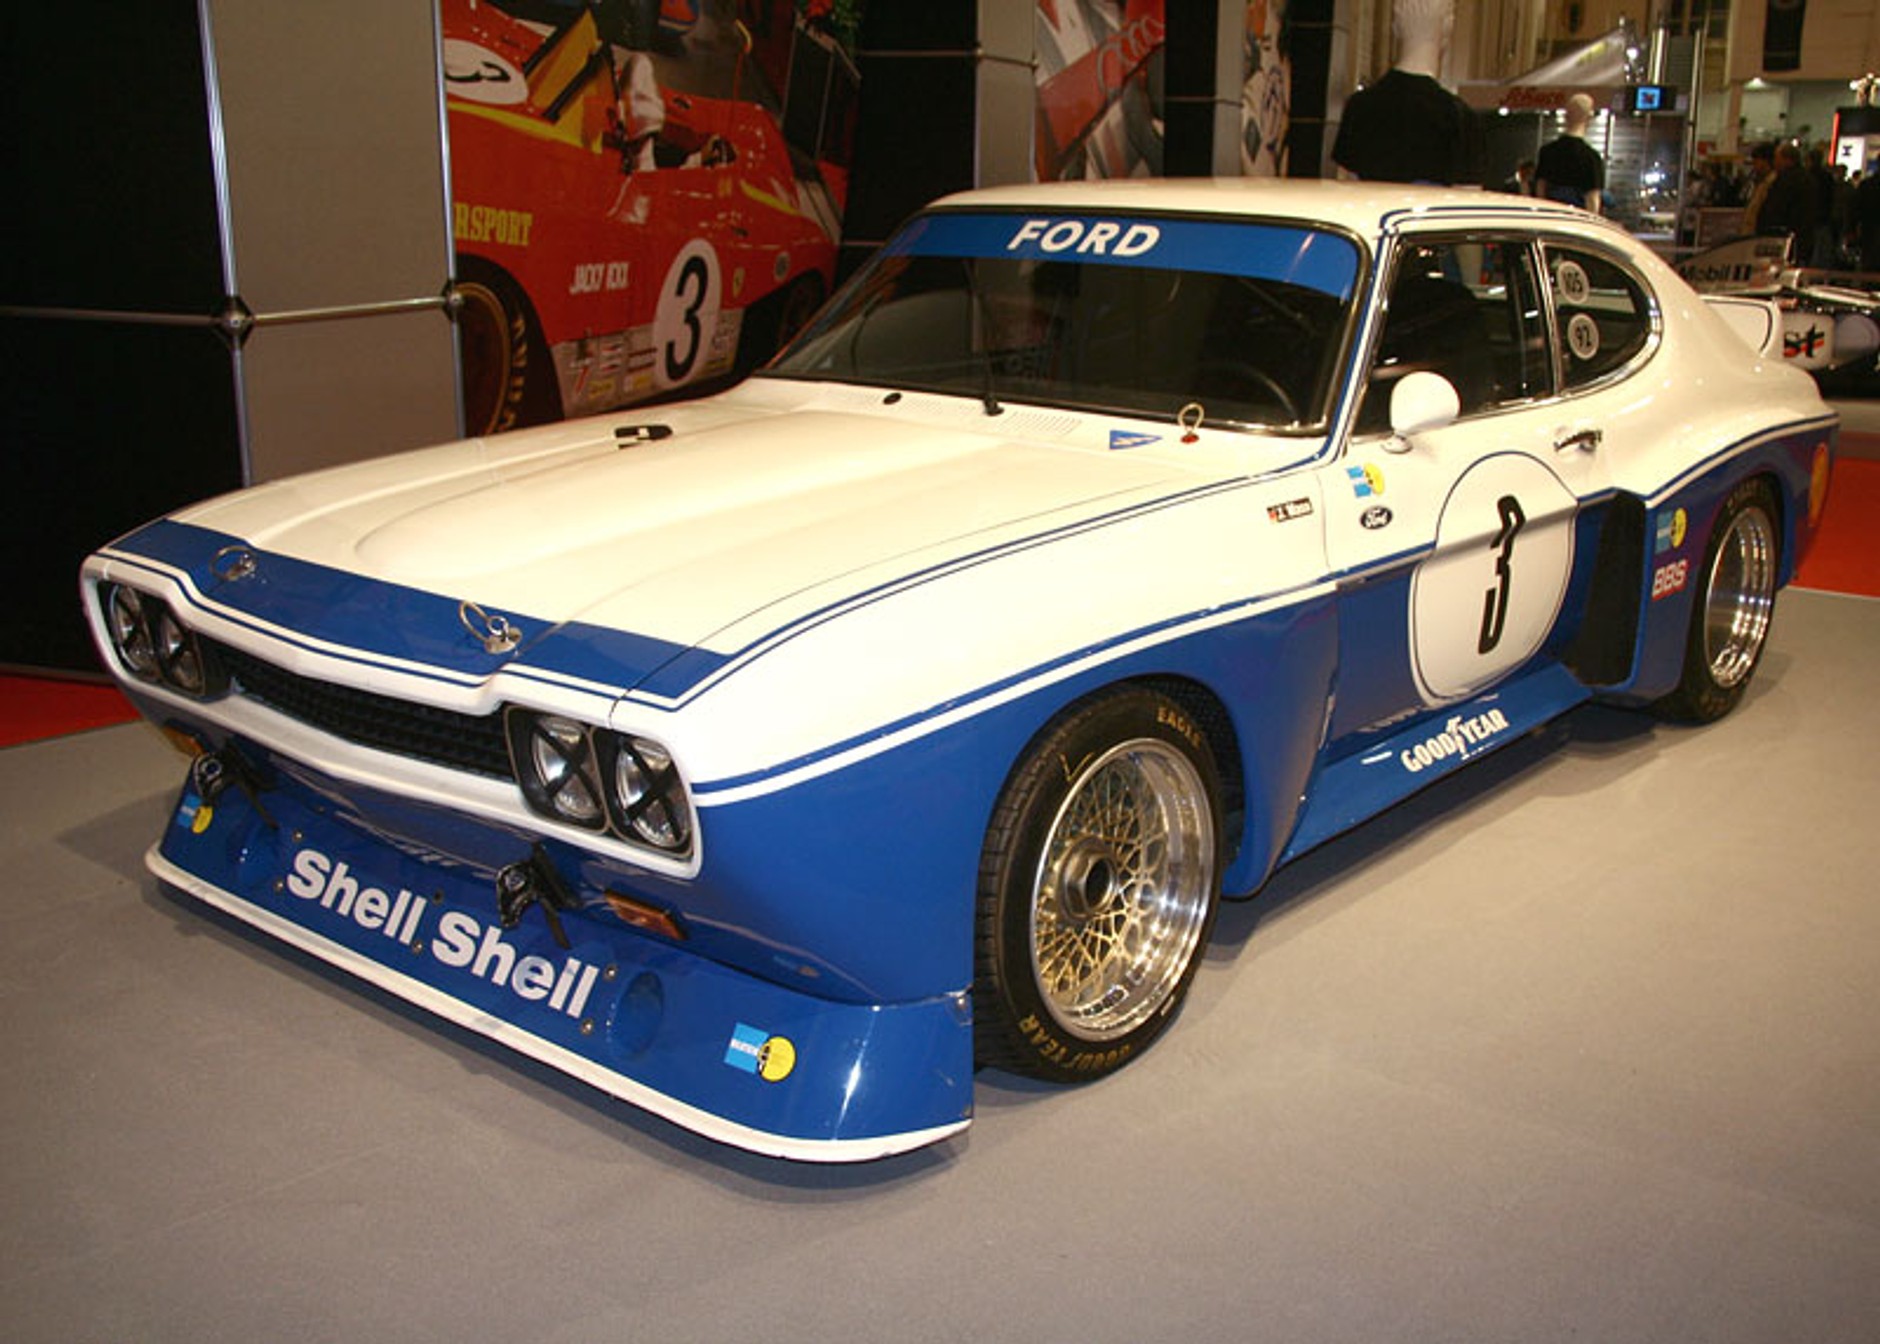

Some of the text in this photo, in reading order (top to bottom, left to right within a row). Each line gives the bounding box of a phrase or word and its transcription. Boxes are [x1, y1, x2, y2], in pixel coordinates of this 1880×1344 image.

[1006, 220, 1160, 258] FORD
[665, 255, 708, 380] 3
[1478, 494, 1526, 654] 3
[1652, 559, 1688, 600] BBS
[287, 849, 599, 1019] Shell Shell
